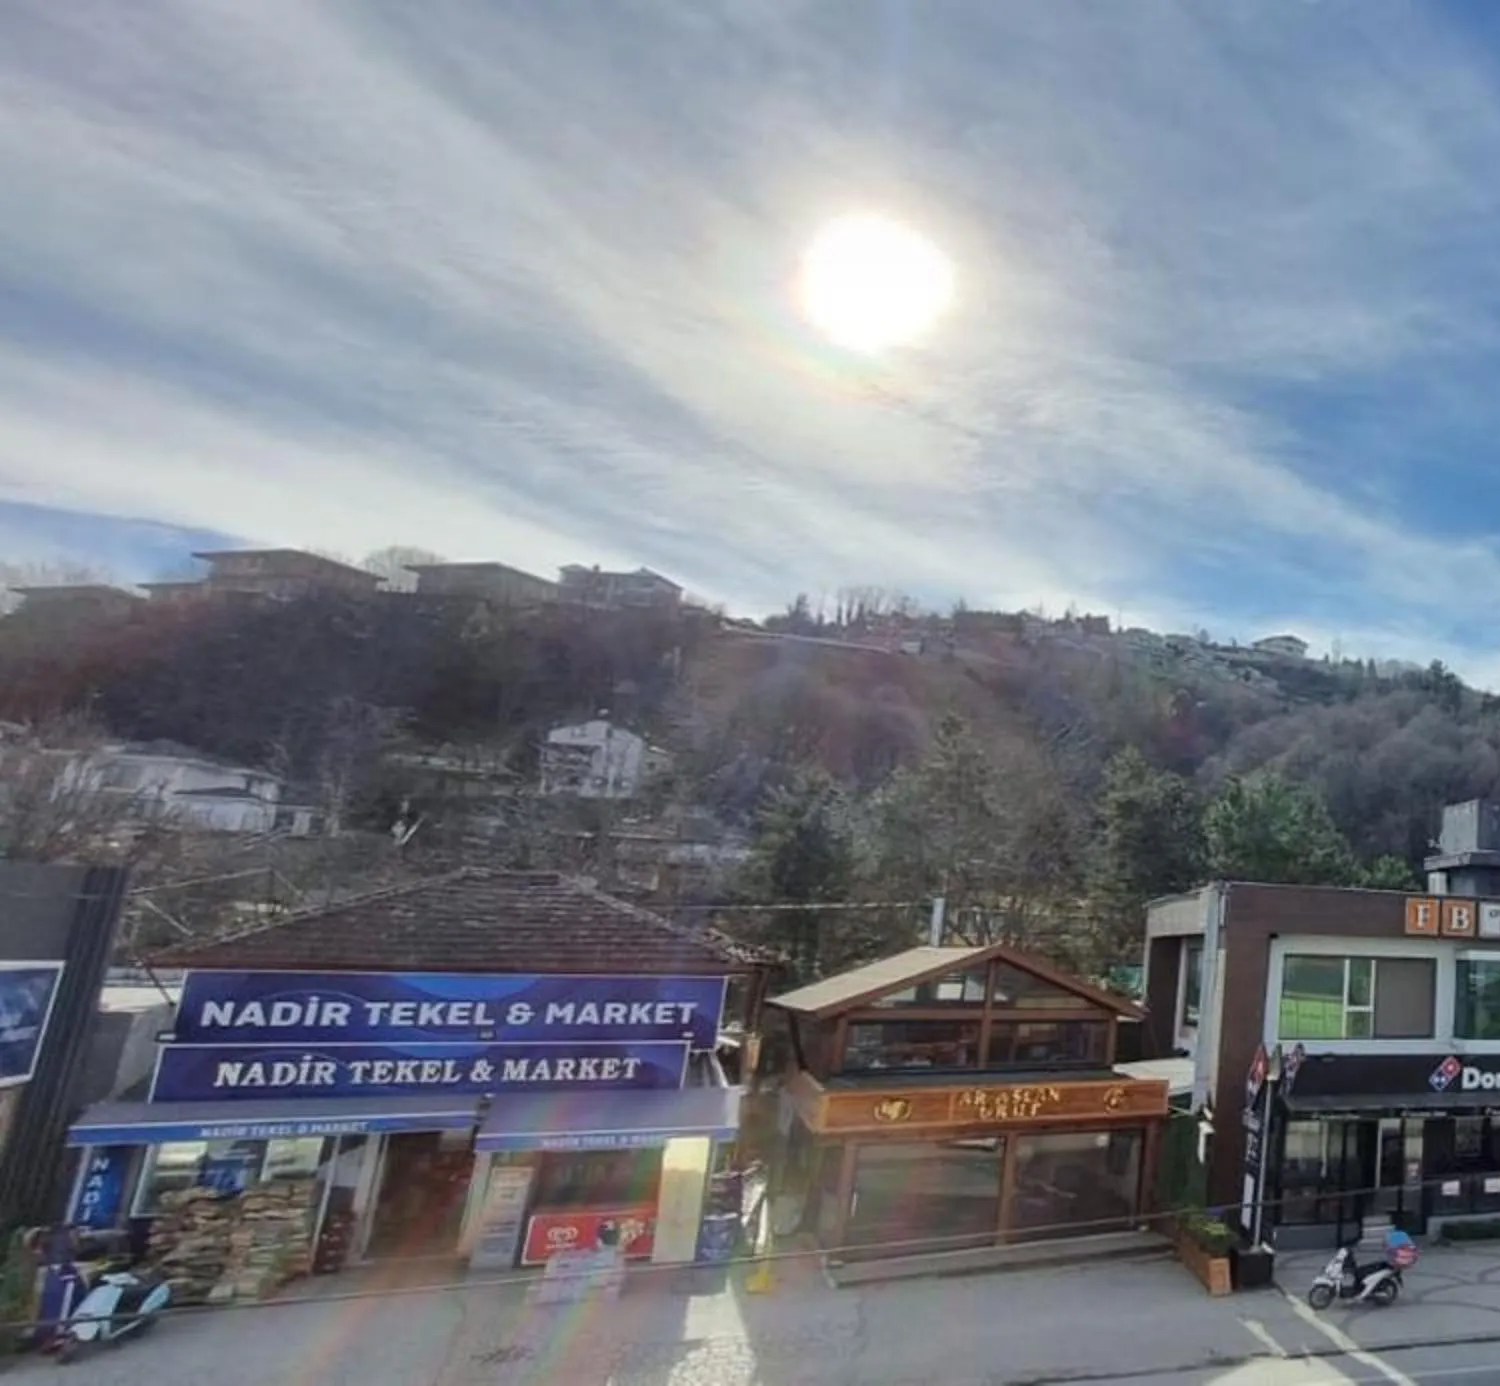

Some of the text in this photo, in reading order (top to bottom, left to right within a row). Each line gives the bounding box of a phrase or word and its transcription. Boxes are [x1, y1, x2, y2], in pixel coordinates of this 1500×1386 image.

[1416, 903, 1470, 929] F B
[201, 995, 699, 1027] NADİR TEKEL & MARKET
[212, 1054, 641, 1088] NADİR TEKEL & MARKET
[252, 1123, 292, 1136] TEKEL
[311, 1120, 370, 1133] MARKET
